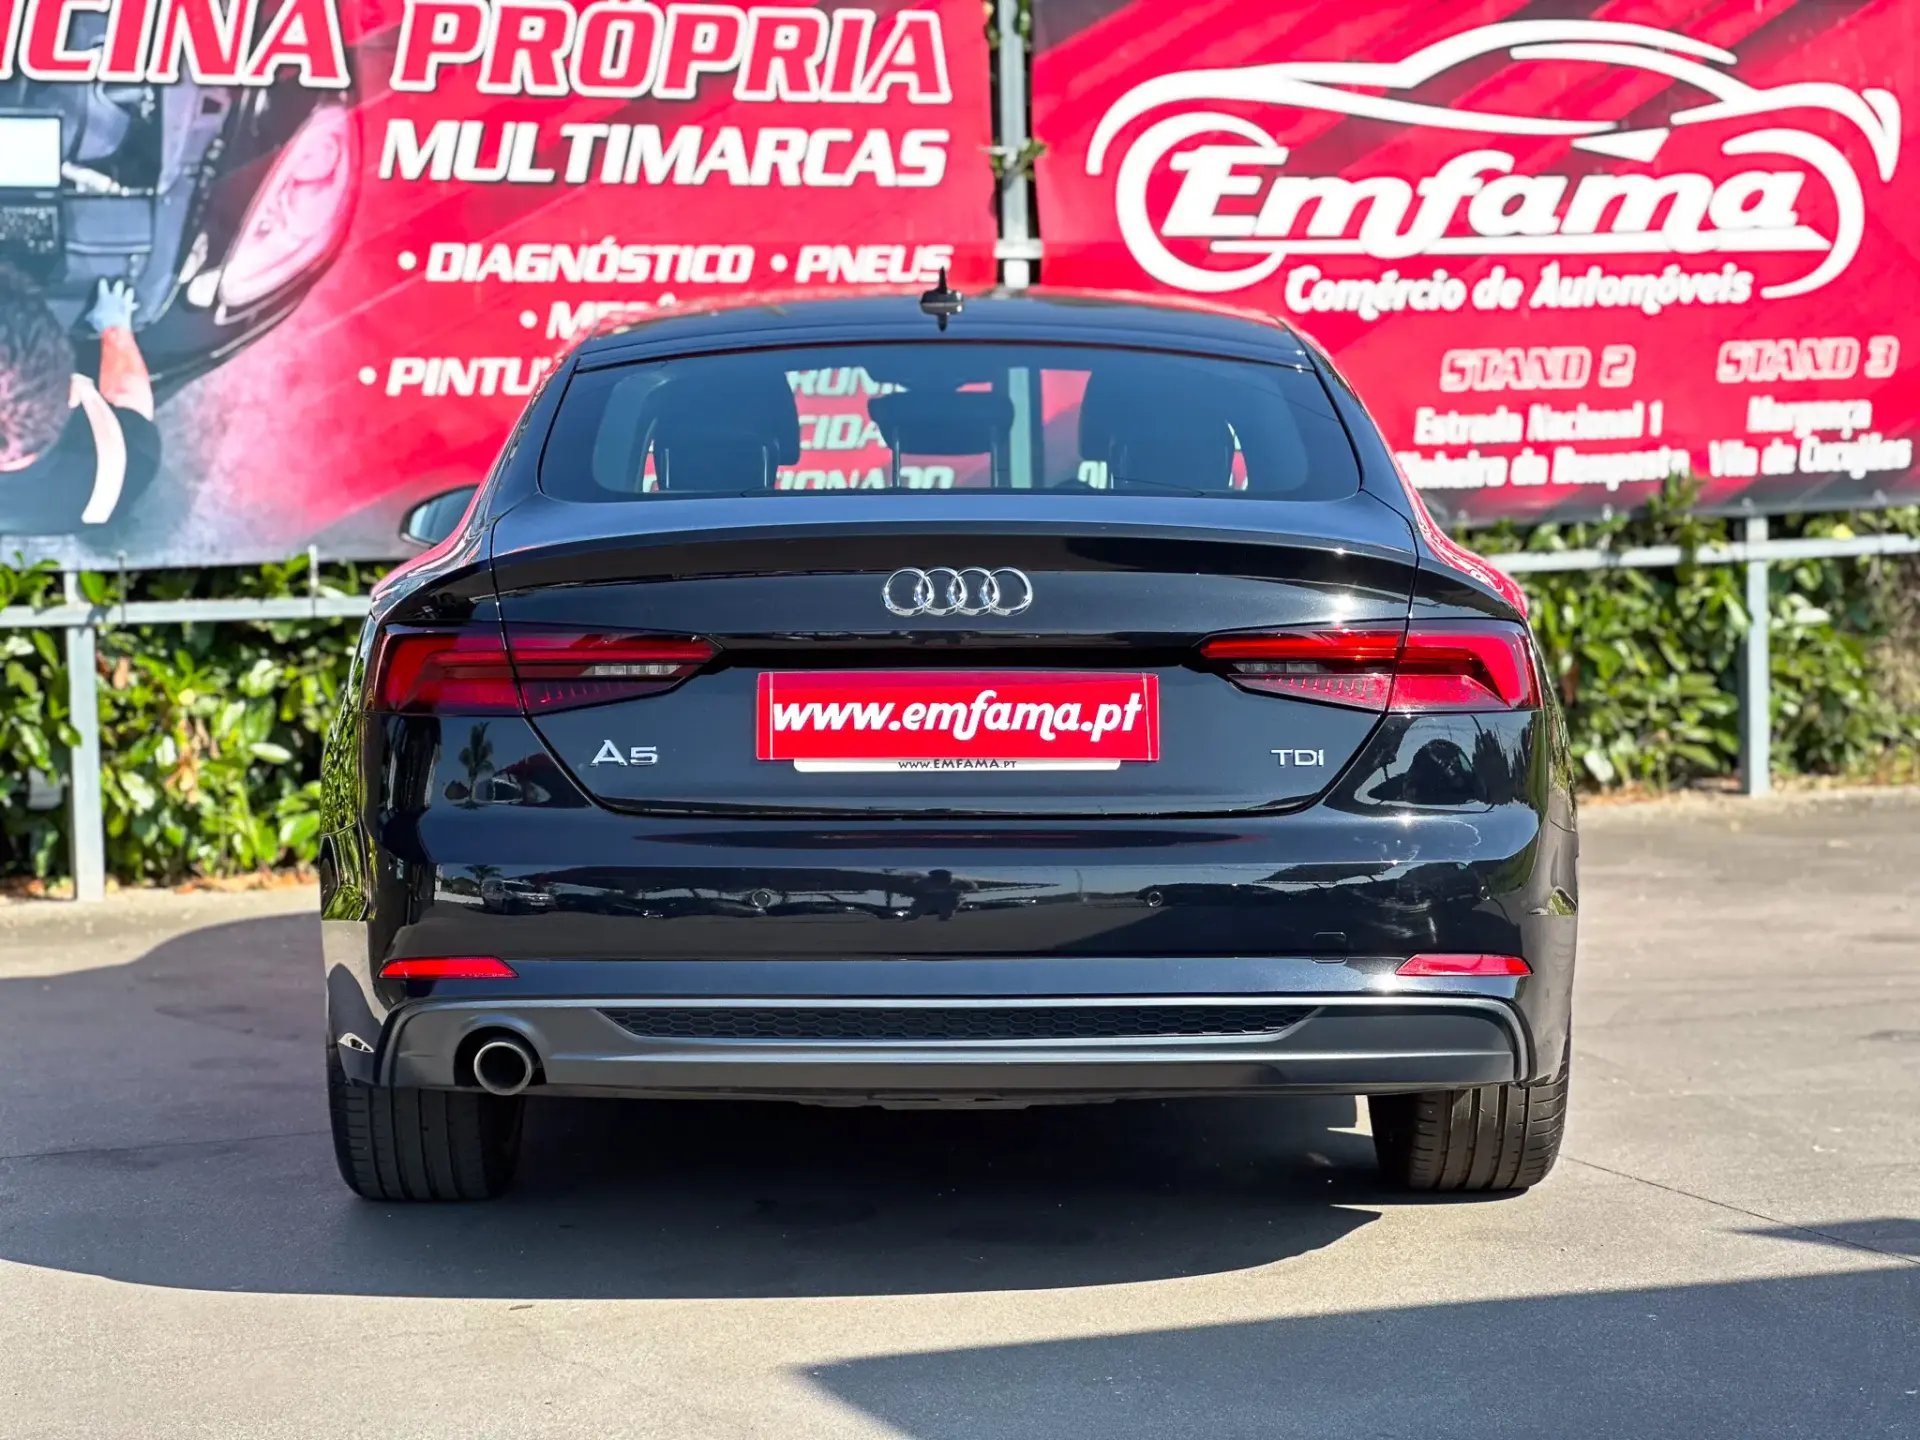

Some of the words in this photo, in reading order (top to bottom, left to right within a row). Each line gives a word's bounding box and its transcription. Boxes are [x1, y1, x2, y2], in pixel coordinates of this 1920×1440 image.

[379, 119, 951, 187] MULTIMARCAS
[1160, 144, 1805, 259] Emfama
[425, 236, 755, 283] DIAGNÓSTICO
[795, 245, 954, 283] PNEUS
[1284, 265, 1468, 322] Comércio
[1472, 266, 1524, 310] de
[1529, 260, 1754, 315] Automóveis
[385, 357, 552, 397] PINTU
[1439, 347, 1593, 393] STAND
[1598, 344, 1638, 388] 2
[1716, 338, 1861, 384] STAND
[1864, 335, 1901, 379] 3
[773, 689, 1143, 742] www.emfama.pt
[590, 739, 658, 766] A5
[1270, 749, 1325, 766] TDI
